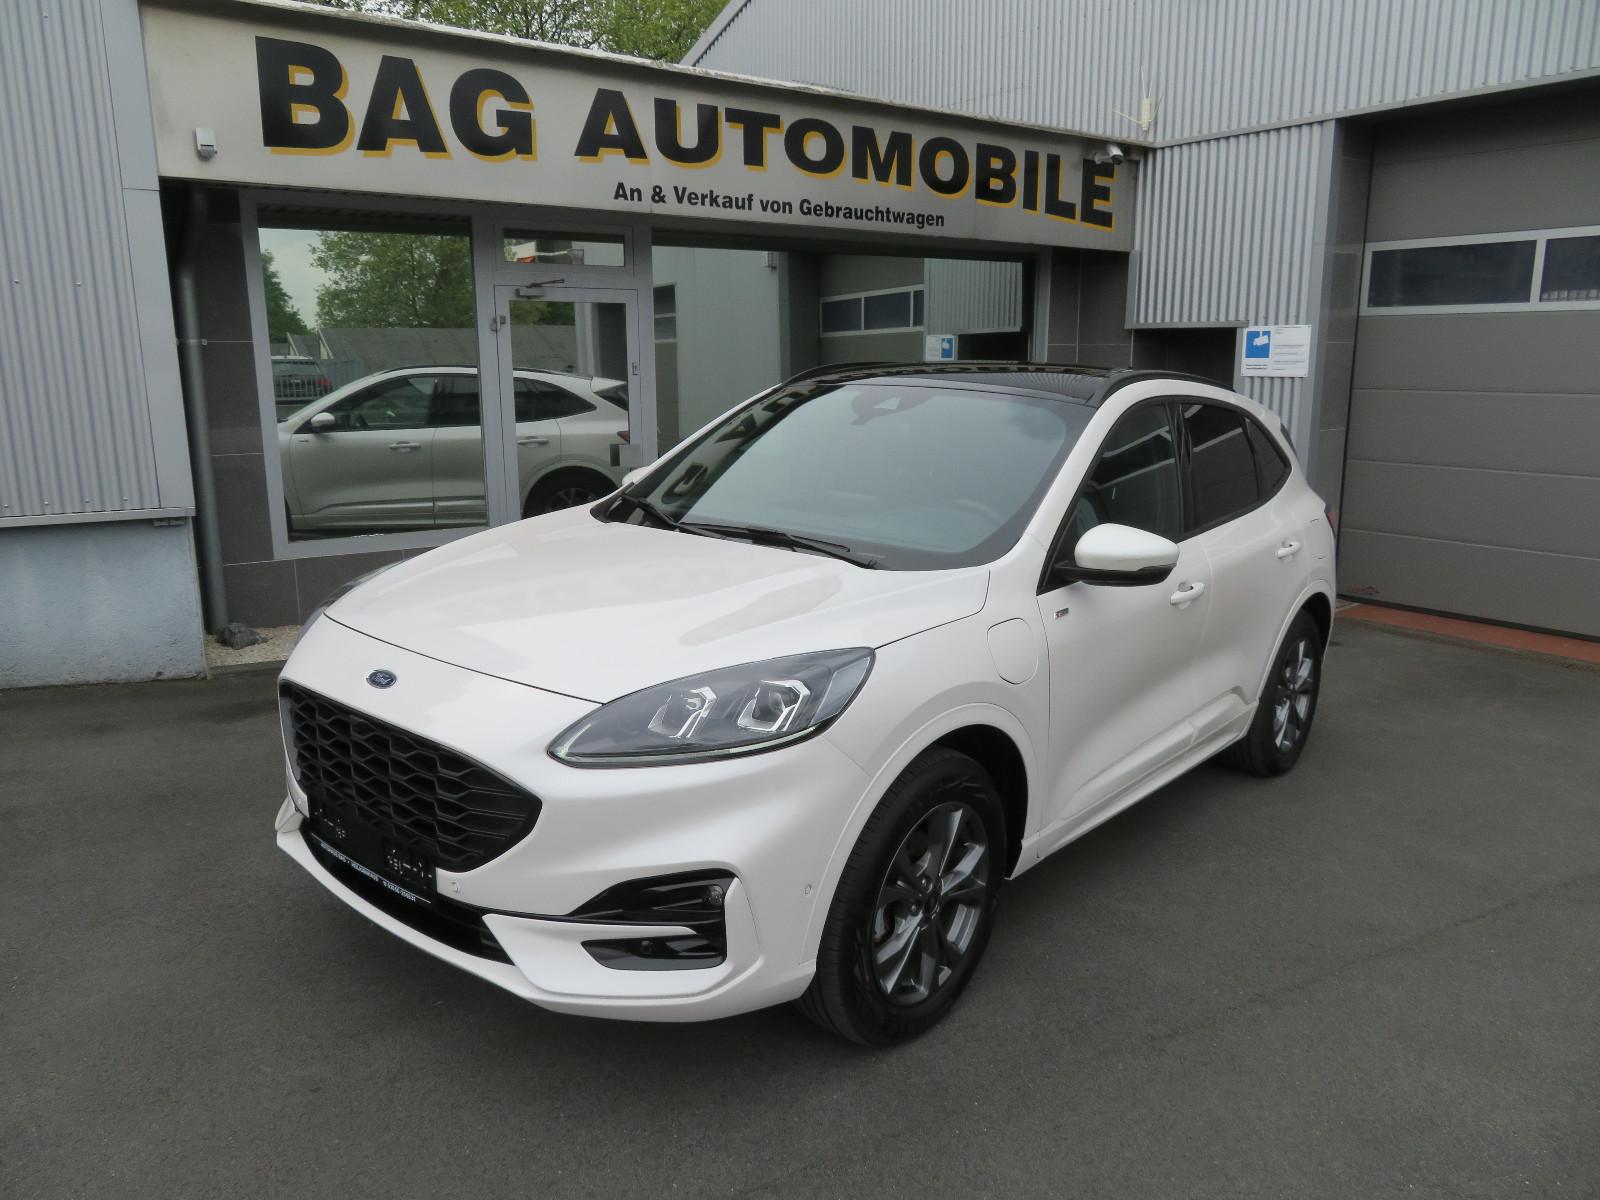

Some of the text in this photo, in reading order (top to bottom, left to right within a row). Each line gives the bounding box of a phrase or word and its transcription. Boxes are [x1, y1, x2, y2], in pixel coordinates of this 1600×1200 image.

[256, 36, 1115, 230] BAG AUTOMOBILE
[613, 182, 945, 229] An & Verkauf von Gebrauchtwagen
